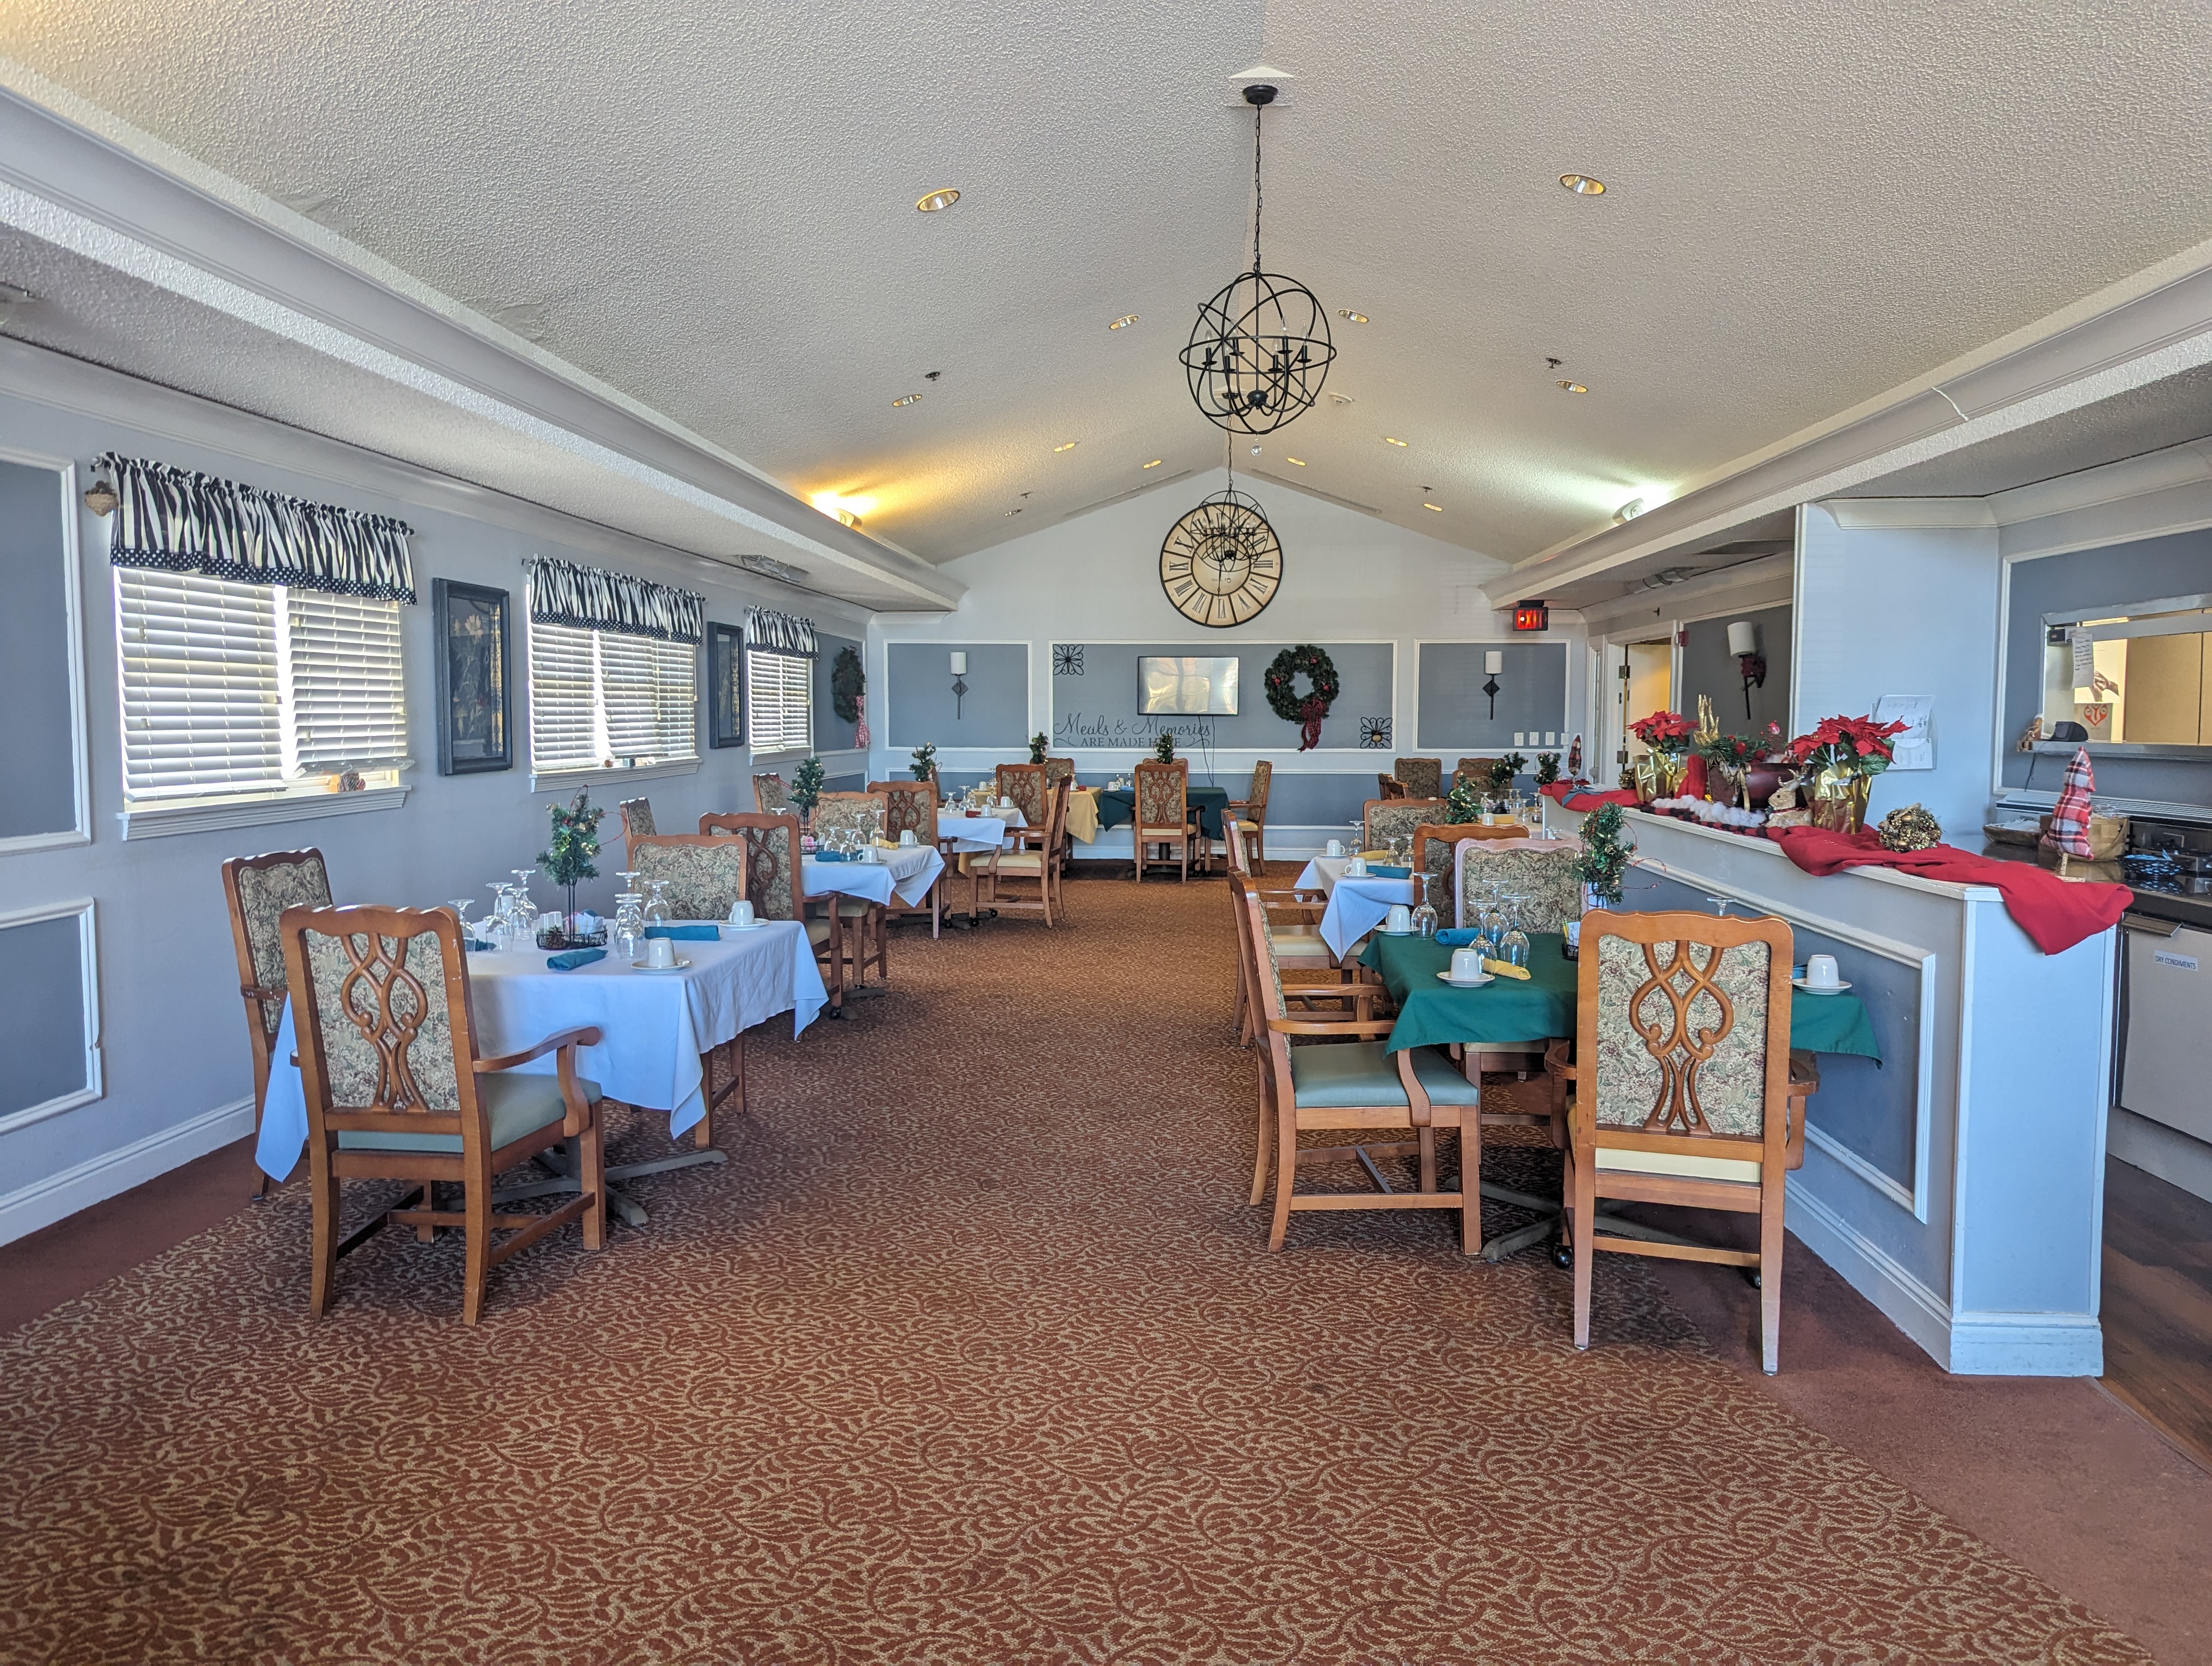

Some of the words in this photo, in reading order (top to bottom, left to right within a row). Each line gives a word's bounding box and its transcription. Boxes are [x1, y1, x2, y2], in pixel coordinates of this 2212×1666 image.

[1516, 610, 1544, 629] EXIT
[1053, 712, 1109, 736] Meals
[1115, 719, 1128, 735] &
[1131, 715, 1210, 736] Memories
[1081, 738, 1105, 747] ARE
[1108, 738, 1144, 747] MADE
[1149, 738, 1181, 747] HE
[2165, 957, 2196, 970] CONDIMENTS
